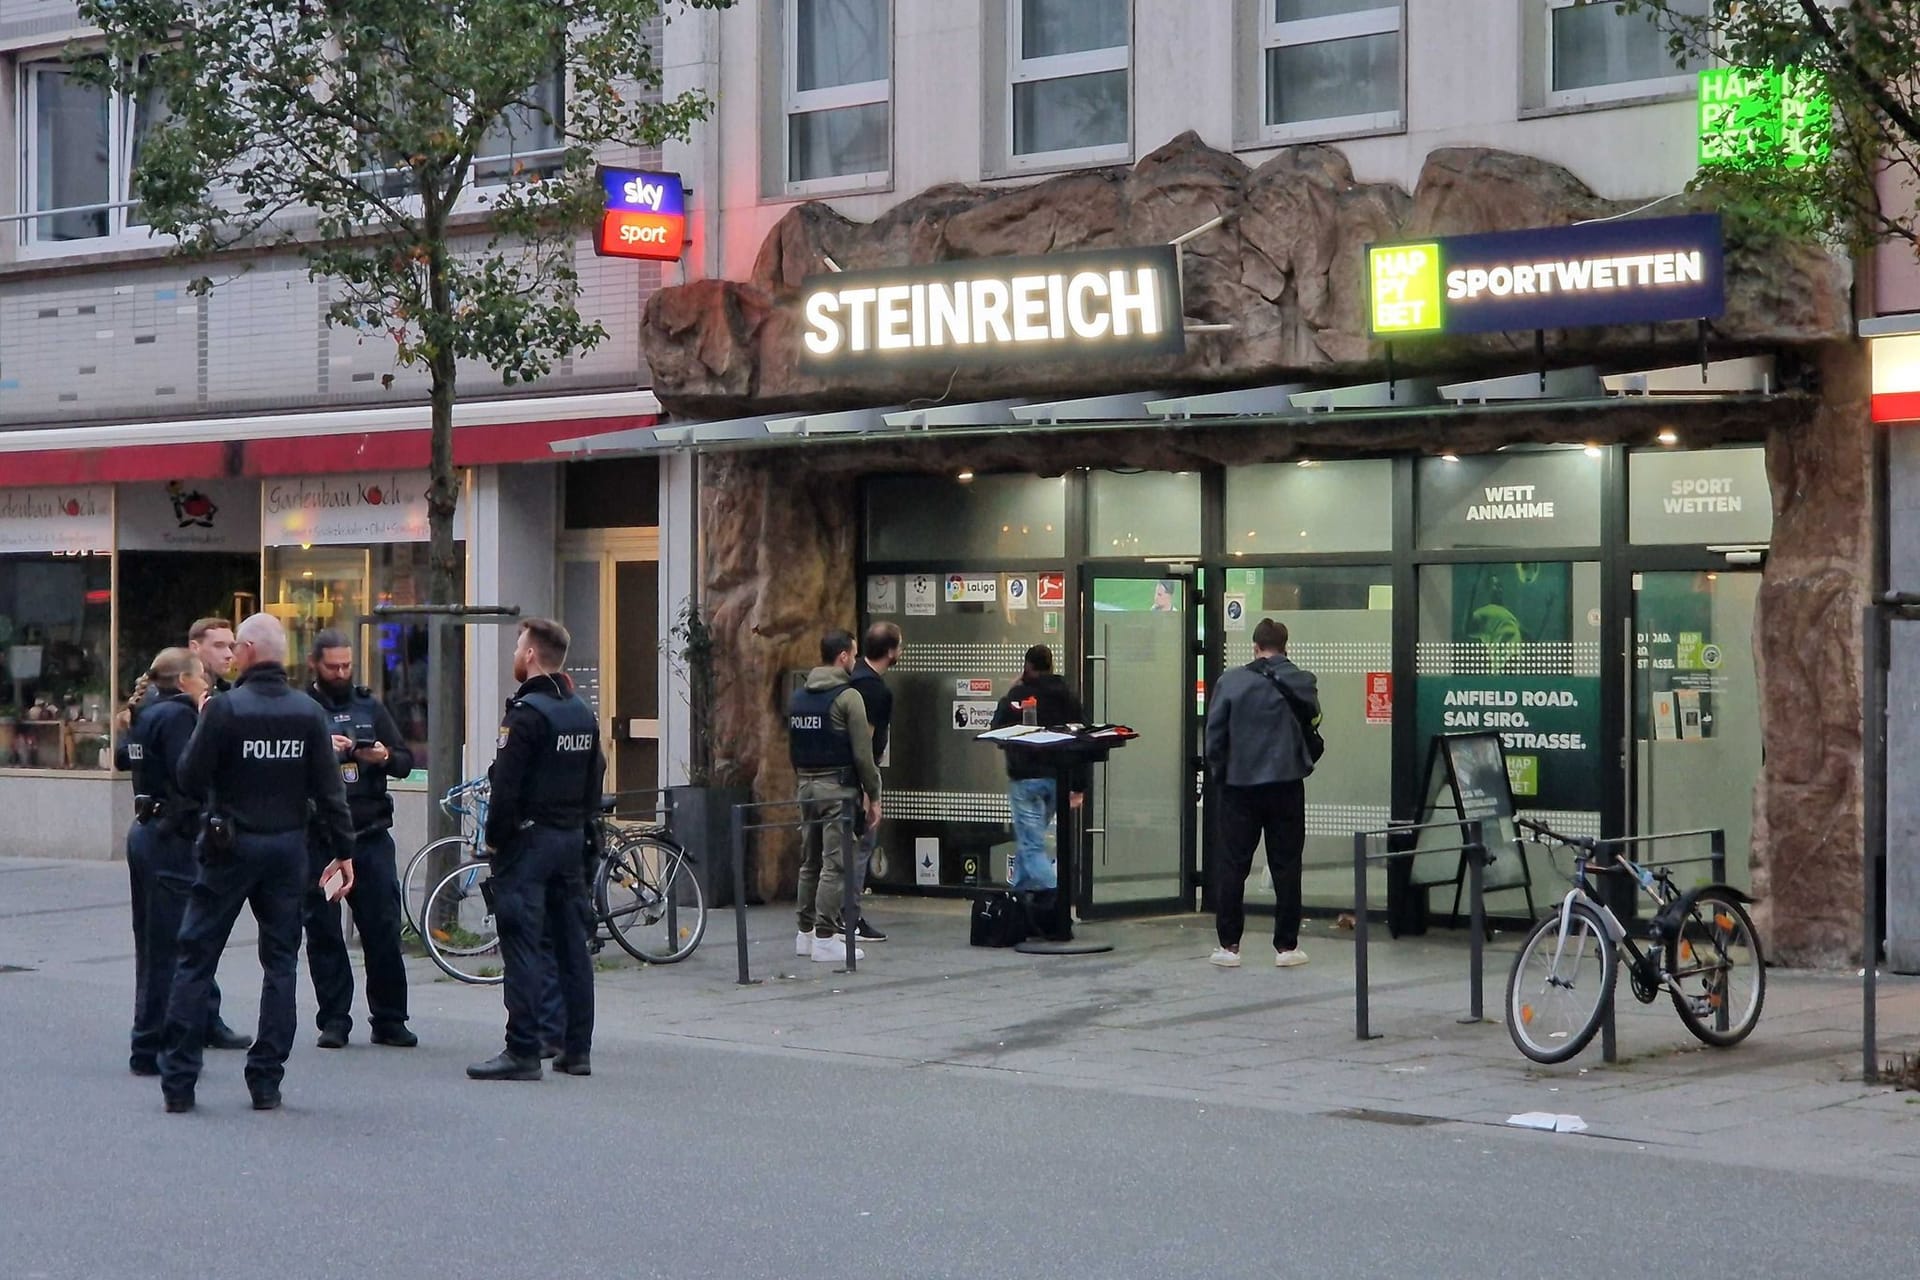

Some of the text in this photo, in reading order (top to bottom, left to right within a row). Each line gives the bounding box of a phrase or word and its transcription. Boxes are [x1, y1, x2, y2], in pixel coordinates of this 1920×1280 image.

[624, 177, 664, 211] sky
[620, 225, 667, 244] sport
[1376, 250, 1427, 275] HAP
[1447, 251, 1701, 299] SPORTWETTEN
[1377, 275, 1408, 301] PY
[804, 267, 1160, 354] STEINREICH
[1378, 301, 1426, 326] BET
[1485, 485, 1535, 502] WETT
[1671, 478, 1732, 494] SPORT
[1466, 503, 1554, 520] ANNAHME
[1663, 496, 1742, 514] WETTEN
[1444, 691, 1578, 707] ANFIELD ROAD.
[970, 706, 994, 717] Premie
[1444, 712, 1530, 728] SAN SIRO.
[791, 716, 822, 729] POLIZEI
[243, 740, 304, 760] POLIZEI
[557, 734, 593, 751] POLIZEI
[1500, 732, 1587, 750] STRASSE.
